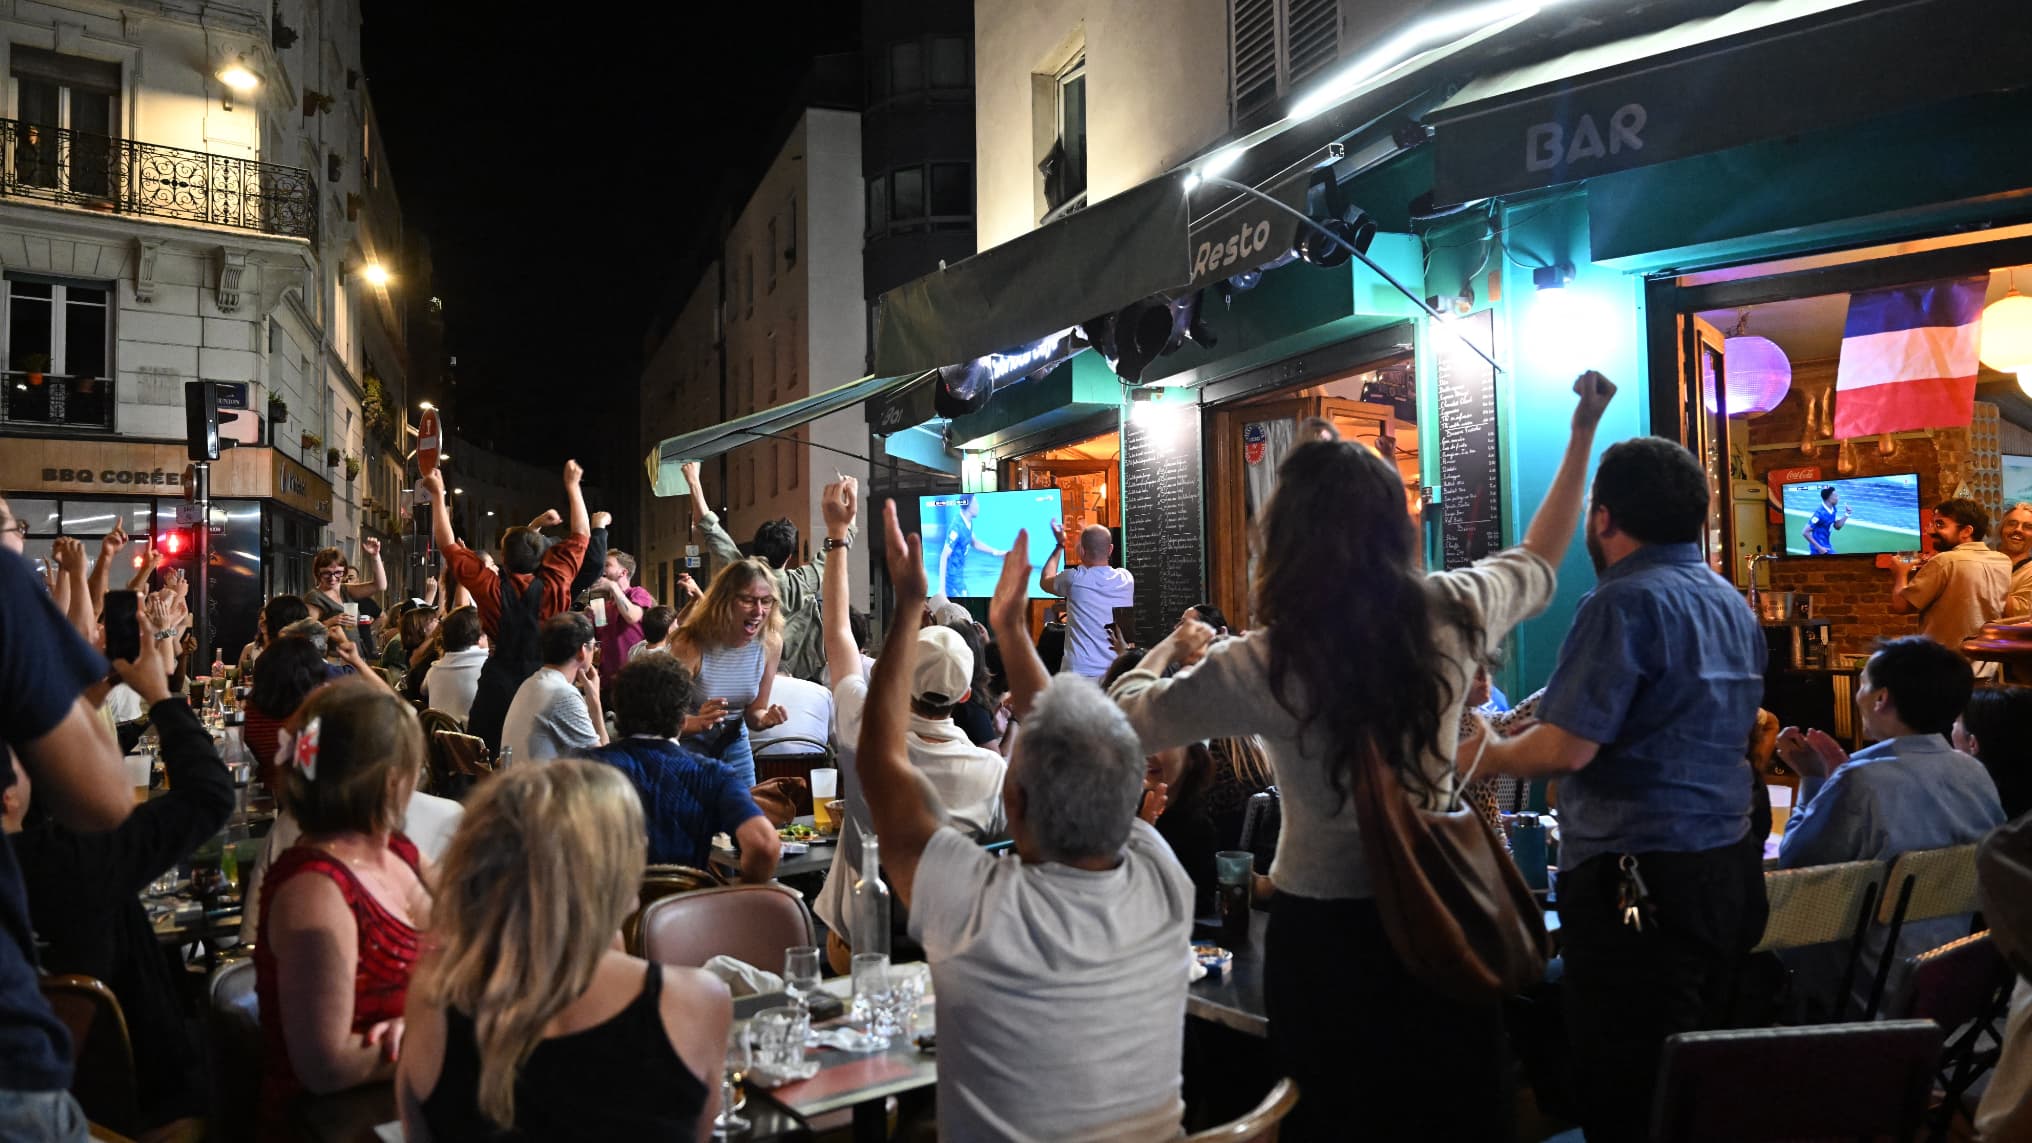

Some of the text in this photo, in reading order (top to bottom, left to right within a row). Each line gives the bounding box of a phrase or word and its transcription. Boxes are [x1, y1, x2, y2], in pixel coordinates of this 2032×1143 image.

[1526, 103, 1648, 172] BAR
[1191, 220, 1270, 281] Resto
[42, 468, 185, 487] BBQ CORÉE
